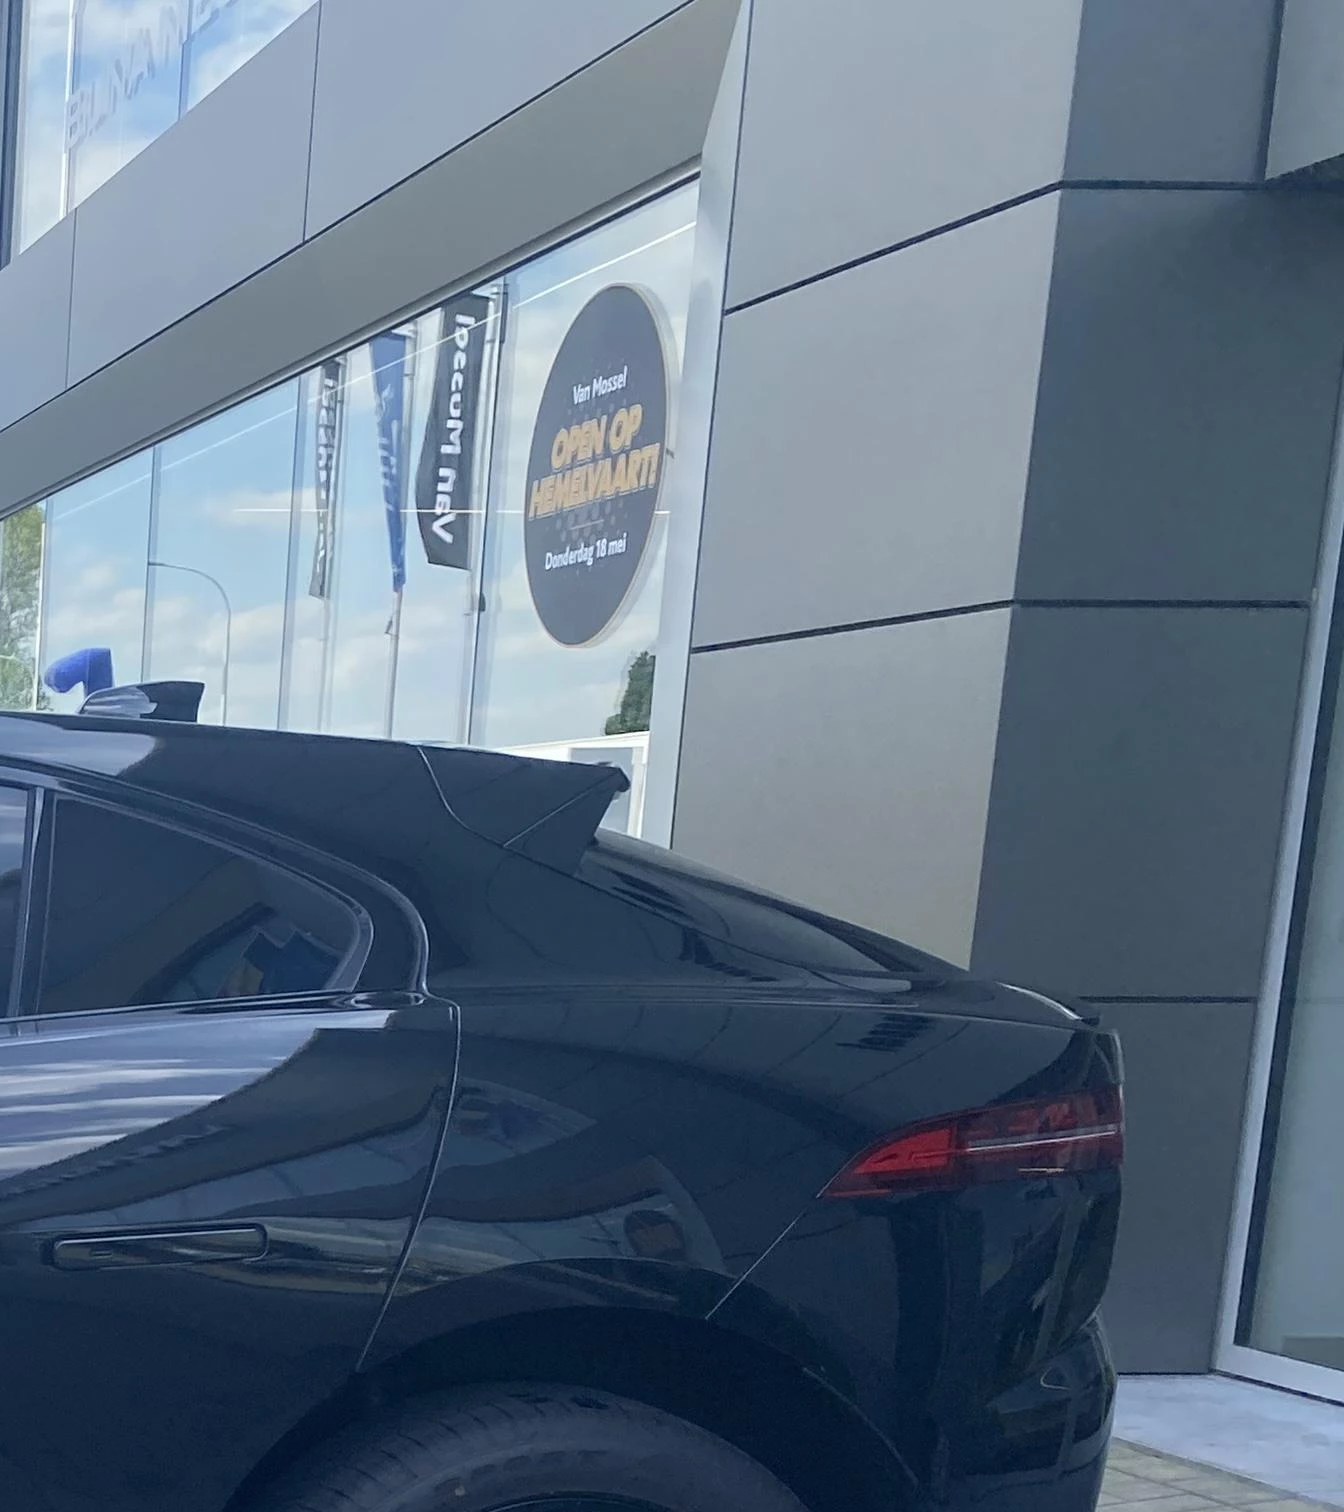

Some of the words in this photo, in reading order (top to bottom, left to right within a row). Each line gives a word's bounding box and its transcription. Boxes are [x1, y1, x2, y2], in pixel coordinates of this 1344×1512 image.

[573, 385, 591, 405] Van
[592, 365, 628, 400] Mossel
[551, 415, 608, 472] OPEN
[609, 404, 643, 454] OP
[545, 544, 595, 571] Donderdag
[596, 537, 607, 558] 18
[608, 533, 628, 557] mei
